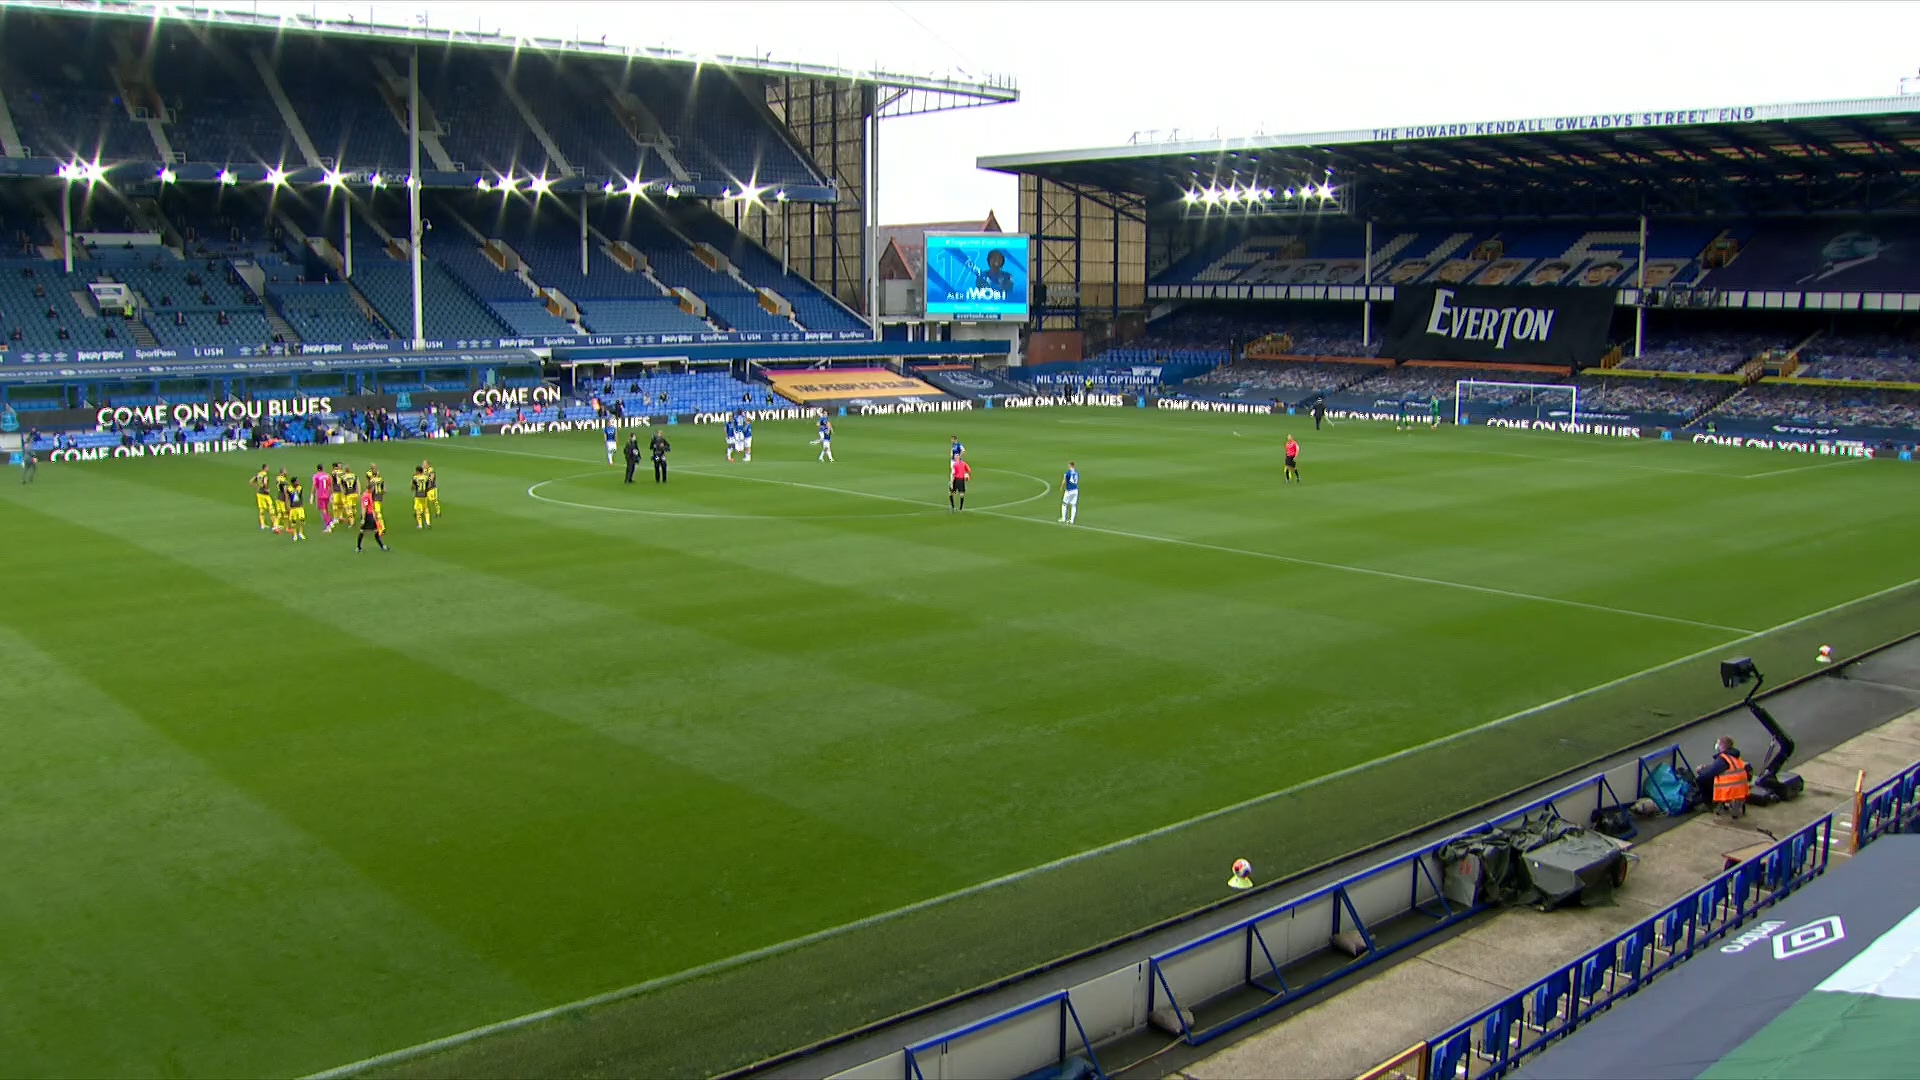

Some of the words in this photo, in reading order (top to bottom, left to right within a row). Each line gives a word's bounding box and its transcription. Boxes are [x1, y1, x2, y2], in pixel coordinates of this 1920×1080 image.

[1373, 128, 1398, 140] THE
[1406, 123, 1467, 139] HOWARD
[1475, 118, 1545, 135] KENDALL
[1555, 114, 1632, 130] GWLADYS
[1643, 110, 1708, 126] STREET
[1719, 107, 1754, 121] END
[1426, 288, 1555, 349] EVERTON
[204, 348, 223, 356] USM
[1037, 375, 1052, 384] NIL
[1056, 375, 1084, 384] SATIS
[1110, 375, 1154, 384] OPTIMUM
[473, 387, 528, 406] COME
[533, 386, 561, 402] ON
[1035, 396, 1053, 407] ON
[1087, 394, 1123, 406] BLUES
[98, 404, 168, 426] COME
[174, 403, 210, 422] ON
[215, 401, 262, 419] YOU
[268, 397, 332, 417] BLUES
[861, 404, 894, 416] COME
[896, 403, 914, 414] ON
[917, 402, 939, 413] YOU
[1157, 398, 1189, 410] COME
[1191, 401, 1209, 412] ON
[1211, 402, 1236, 412] YOU
[759, 409, 784, 420] YOU
[501, 422, 545, 435] COME
[549, 421, 571, 432] ON
[575, 418, 605, 431] YOU
[1486, 417, 1529, 429] COME
[1532, 420, 1555, 431] ON
[1559, 422, 1591, 434] YOU
[51, 447, 109, 462] COME
[114, 445, 145, 458] ON
[149, 442, 189, 457] YOU
[1693, 434, 1744, 447] COME
[1746, 438, 1774, 450] ON
[1777, 441, 1816, 454] YOU
